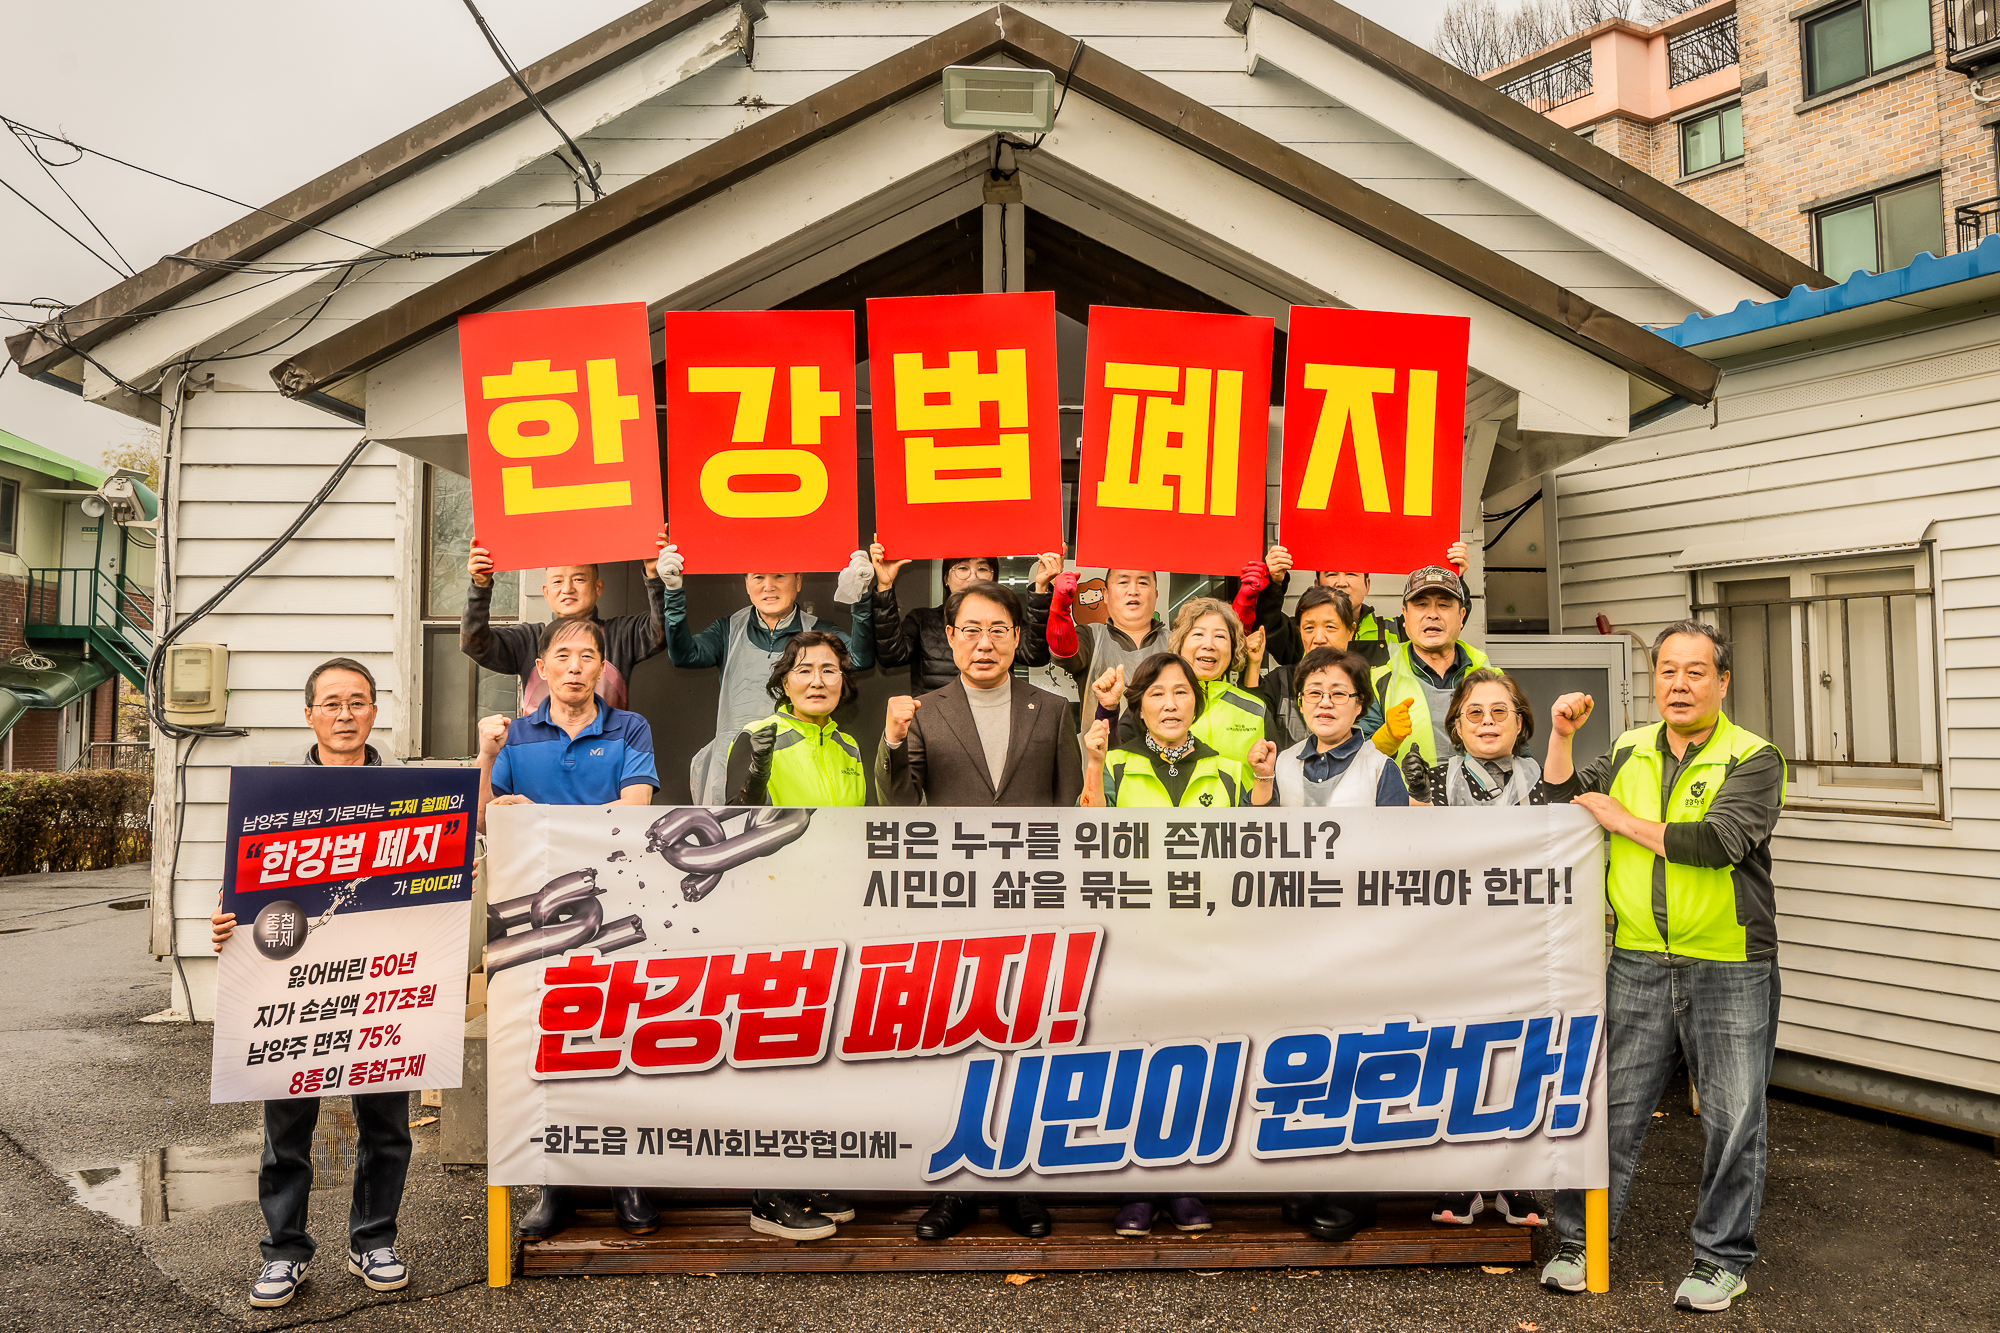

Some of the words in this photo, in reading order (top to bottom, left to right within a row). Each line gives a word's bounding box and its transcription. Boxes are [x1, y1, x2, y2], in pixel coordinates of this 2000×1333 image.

[482, 358, 640, 516] 한
[688, 366, 841, 518] 강
[893, 348, 1031, 504] 법
[1096, 361, 1244, 517] 폐
[1296, 363, 1438, 517] 지
[242, 812, 287, 831] 남양주
[292, 808, 321, 826] 발전
[325, 803, 383, 822] 가로막는
[388, 798, 417, 816] 규제
[421, 794, 463, 812] 철폐와
[246, 831, 365, 883] “한강법
[371, 819, 458, 868] 폐지”
[866, 821, 939, 860] 법은
[951, 821, 1061, 860] 누구를
[1074, 821, 1149, 859] 위해
[1163, 820, 1341, 860] 존재하나?
[391, 880, 406, 895] 가
[409, 873, 461, 894] 답이다!!
[863, 870, 976, 909] 시민의
[992, 870, 1067, 909] 삶을
[1080, 871, 1153, 909] 묶는
[1167, 871, 1216, 917] 법,
[1231, 870, 1344, 908] 이제는
[1357, 868, 1472, 907] 바꿔야
[1483, 866, 1573, 907] 한다!
[264, 930, 293, 947] 규제
[266, 912, 293, 929] 중첩
[287, 956, 366, 988] 잃어버린
[369, 951, 416, 978] 50년
[253, 1001, 294, 1028] 지가
[299, 993, 359, 1022] 손실액
[362, 983, 436, 1014] 217조원
[534, 947, 840, 1074] 한강법
[842, 931, 1098, 1055] 폐지!
[246, 1034, 307, 1066] 남양주
[312, 1028, 351, 1056] 면적
[357, 1022, 401, 1050] 75%
[288, 1064, 343, 1094] 8종의
[348, 1053, 425, 1086] 중첩규제
[928, 1041, 1242, 1174] 시민이
[1256, 1015, 1598, 1152] 원한다!
[529, 1124, 628, 1157] -화도읍
[636, 1126, 913, 1160] 지역사회보장협의체-
